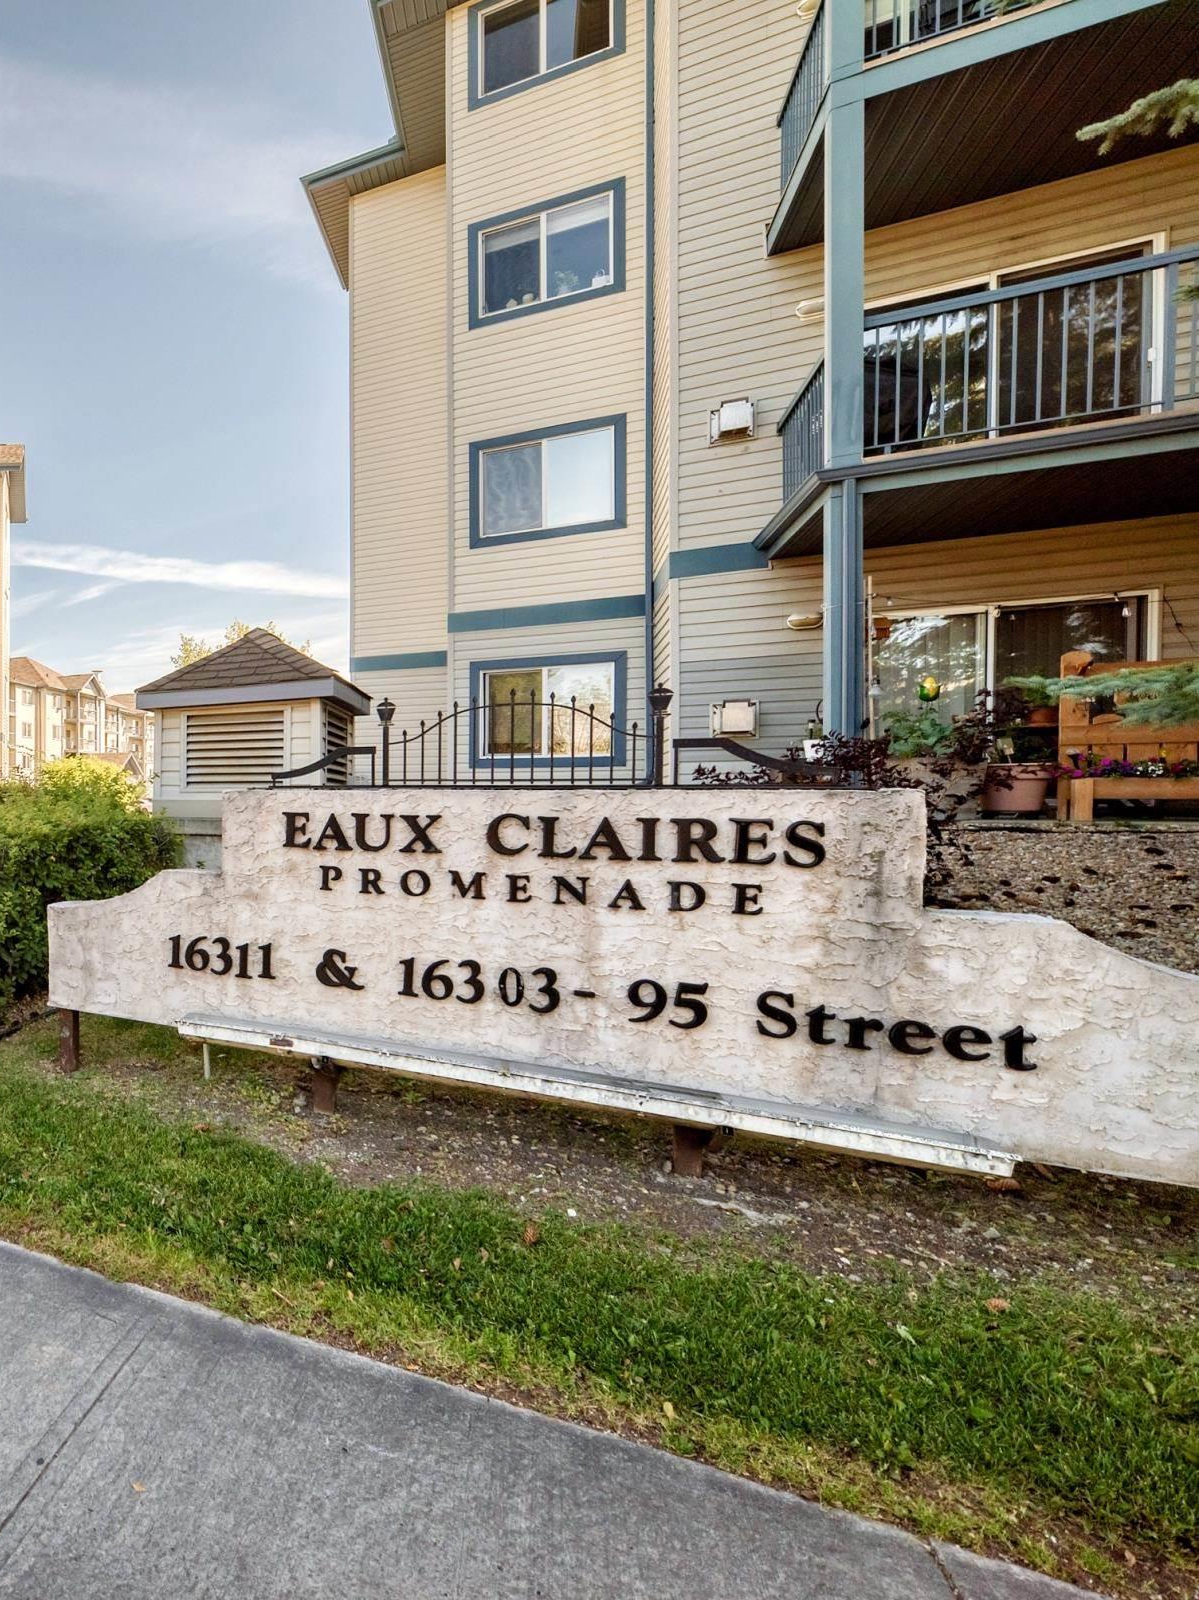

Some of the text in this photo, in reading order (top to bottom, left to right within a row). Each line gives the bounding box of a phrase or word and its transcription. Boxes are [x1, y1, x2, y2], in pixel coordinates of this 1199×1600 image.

[282, 811, 826, 869] EAUX CLAIRES
[320, 865, 765, 916] PROMENADE
[167, 934, 277, 981] 16311
[315, 948, 365, 991] &
[627, 979, 710, 1030] 95
[756, 990, 1039, 1073] Street
